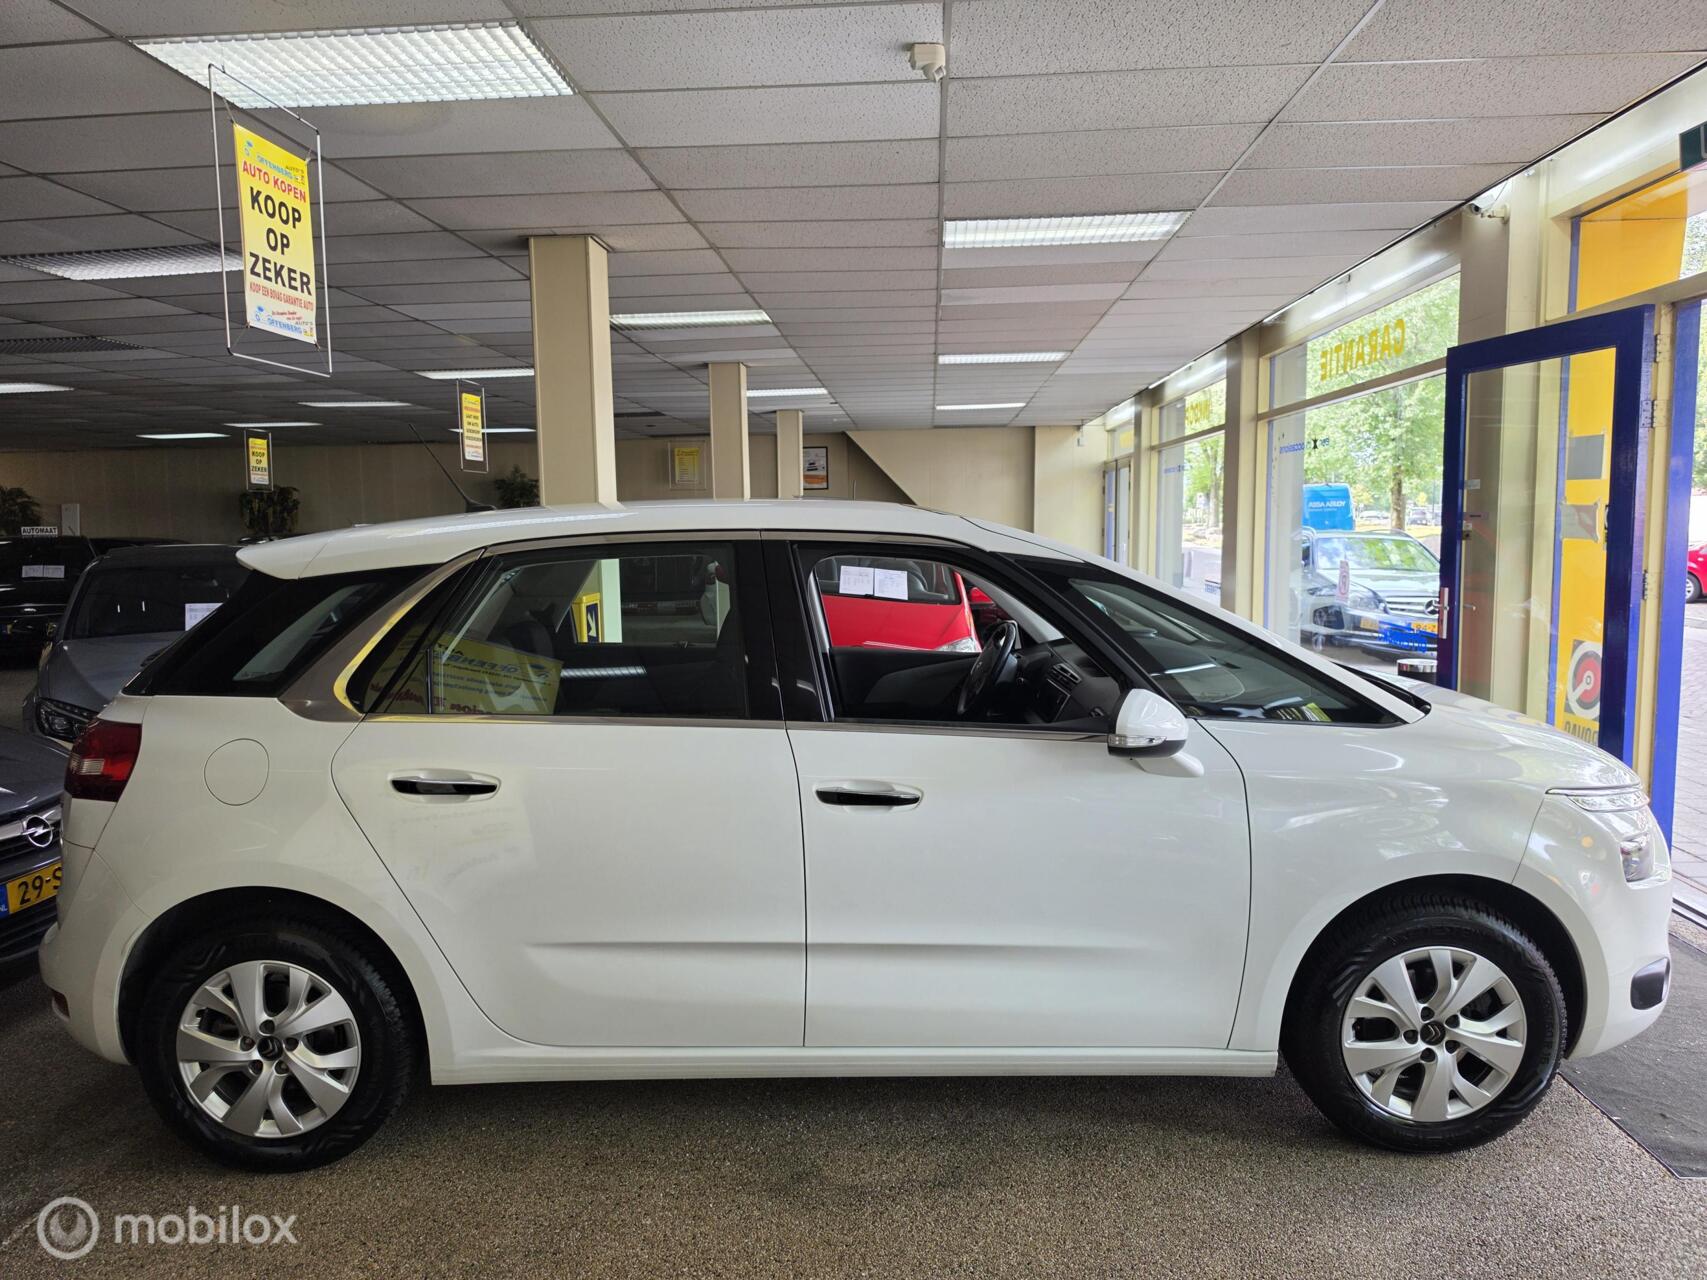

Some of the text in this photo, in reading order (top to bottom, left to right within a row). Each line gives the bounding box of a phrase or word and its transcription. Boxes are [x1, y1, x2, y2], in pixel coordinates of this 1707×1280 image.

[242, 160, 306, 203] AUTO KOPEN
[250, 186, 302, 229] KOOP
[266, 227, 290, 256] OP
[249, 251, 312, 297] ZEKER
[22, 527, 58, 535] AUTOMAAT
